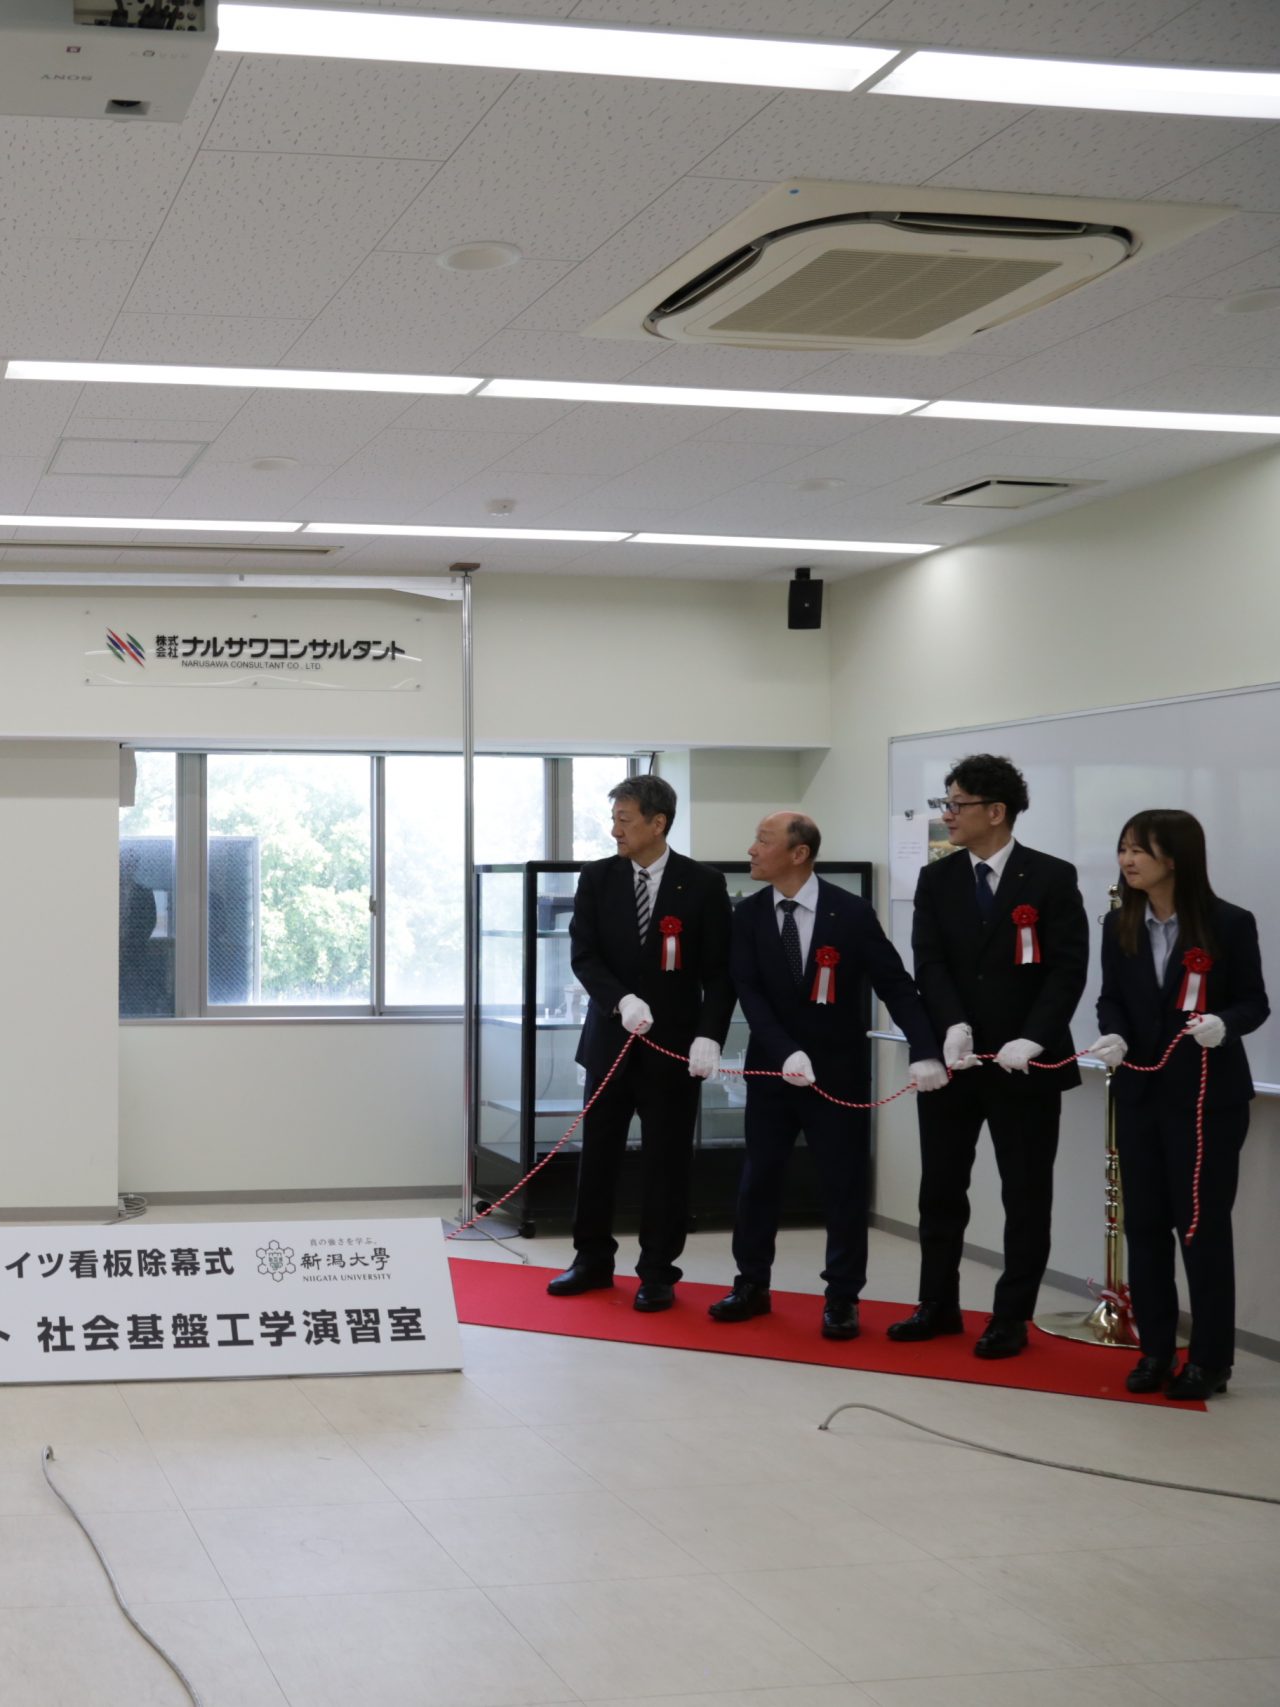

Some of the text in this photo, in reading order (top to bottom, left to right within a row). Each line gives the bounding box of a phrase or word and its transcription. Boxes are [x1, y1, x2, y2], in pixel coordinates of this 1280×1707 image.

[40, 74, 93, 82] SONY
[181, 636, 406, 660] ナルサワコンサルタント
[181, 660, 229, 668] NARUSAWA
[230, 661, 285, 669] CONSULTANT
[303, 1273, 392, 1282] NIIGATA UNIVERSITY
[37, 1306, 427, 1354] 社会基盤工学演習室
